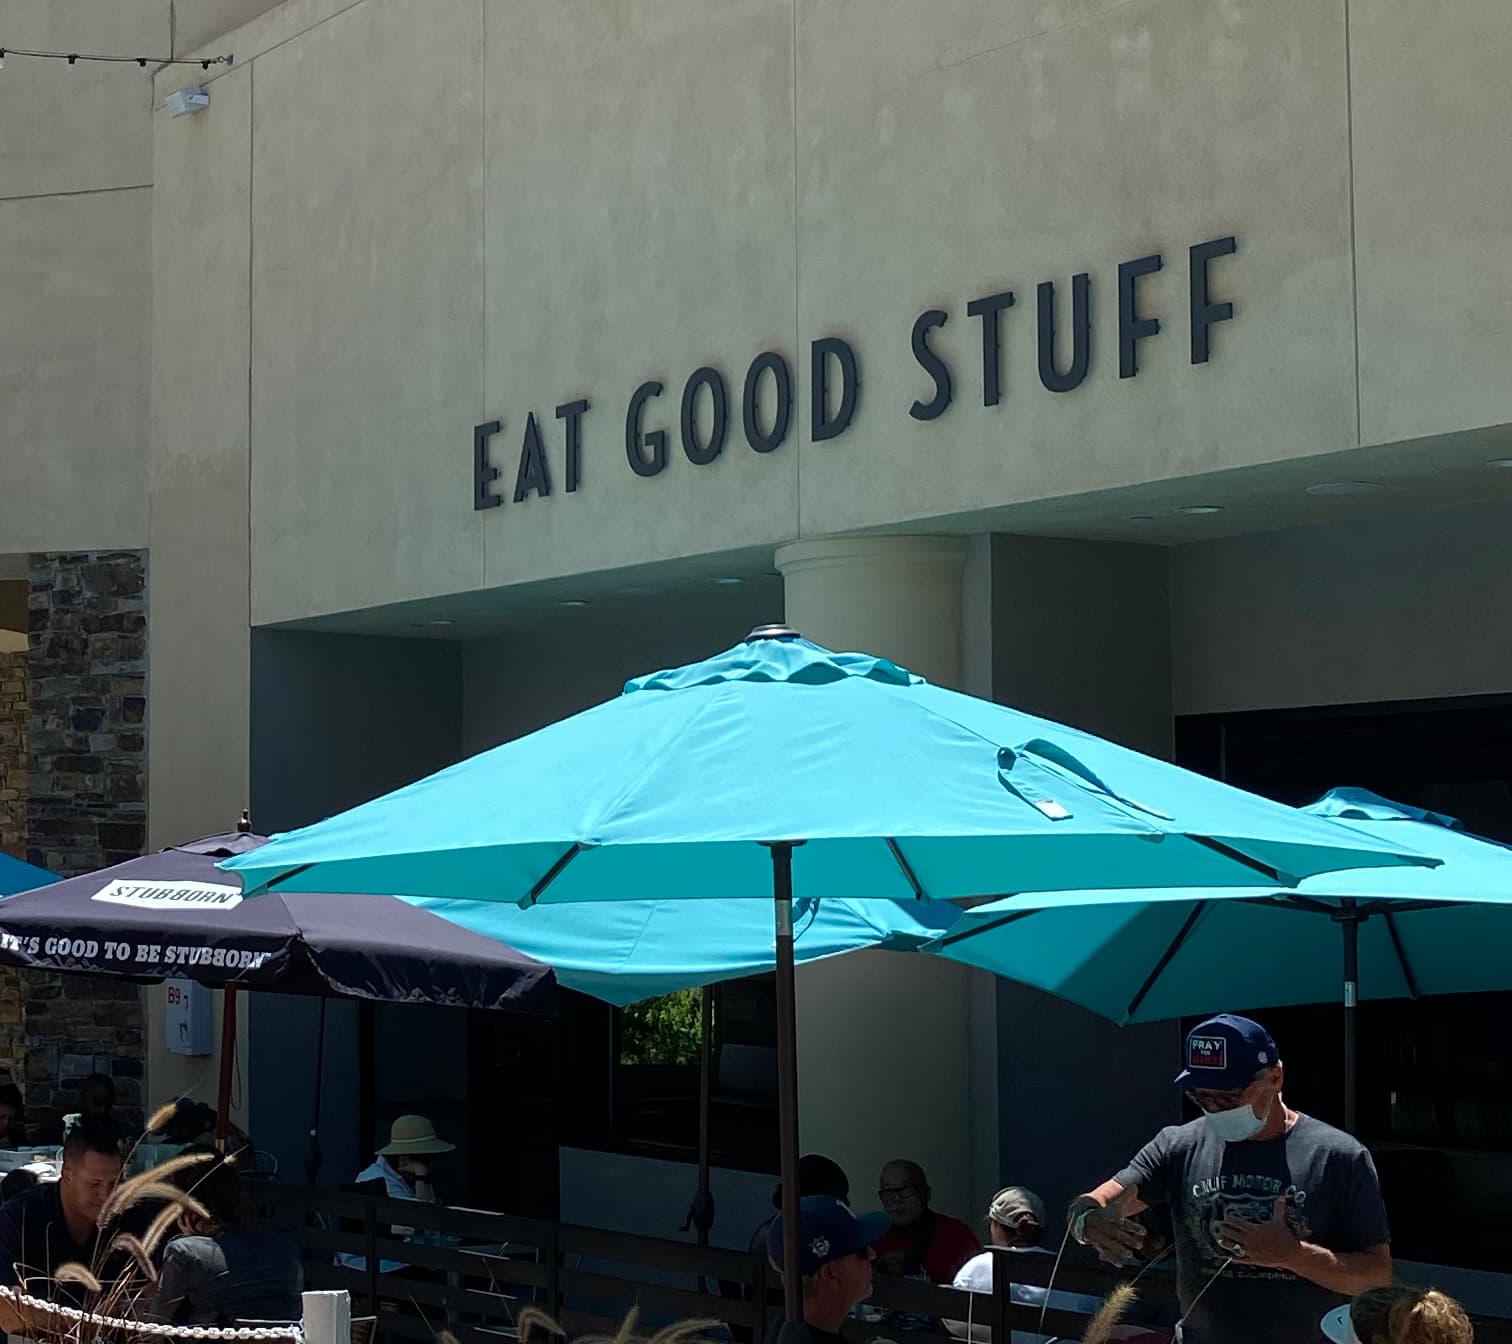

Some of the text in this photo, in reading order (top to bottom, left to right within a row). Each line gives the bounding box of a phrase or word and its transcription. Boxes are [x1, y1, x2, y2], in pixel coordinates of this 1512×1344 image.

[472, 235, 1238, 511] EAT GOOD STUFF
[109, 886, 234, 903] STUBBORN
[0, 933, 265, 969] IT'S GOOD TO BE STUBBORN
[167, 986, 181, 1005] B9
[1192, 1040, 1223, 1051] PRAY
[1232, 1173, 1283, 1194] MOTOR
